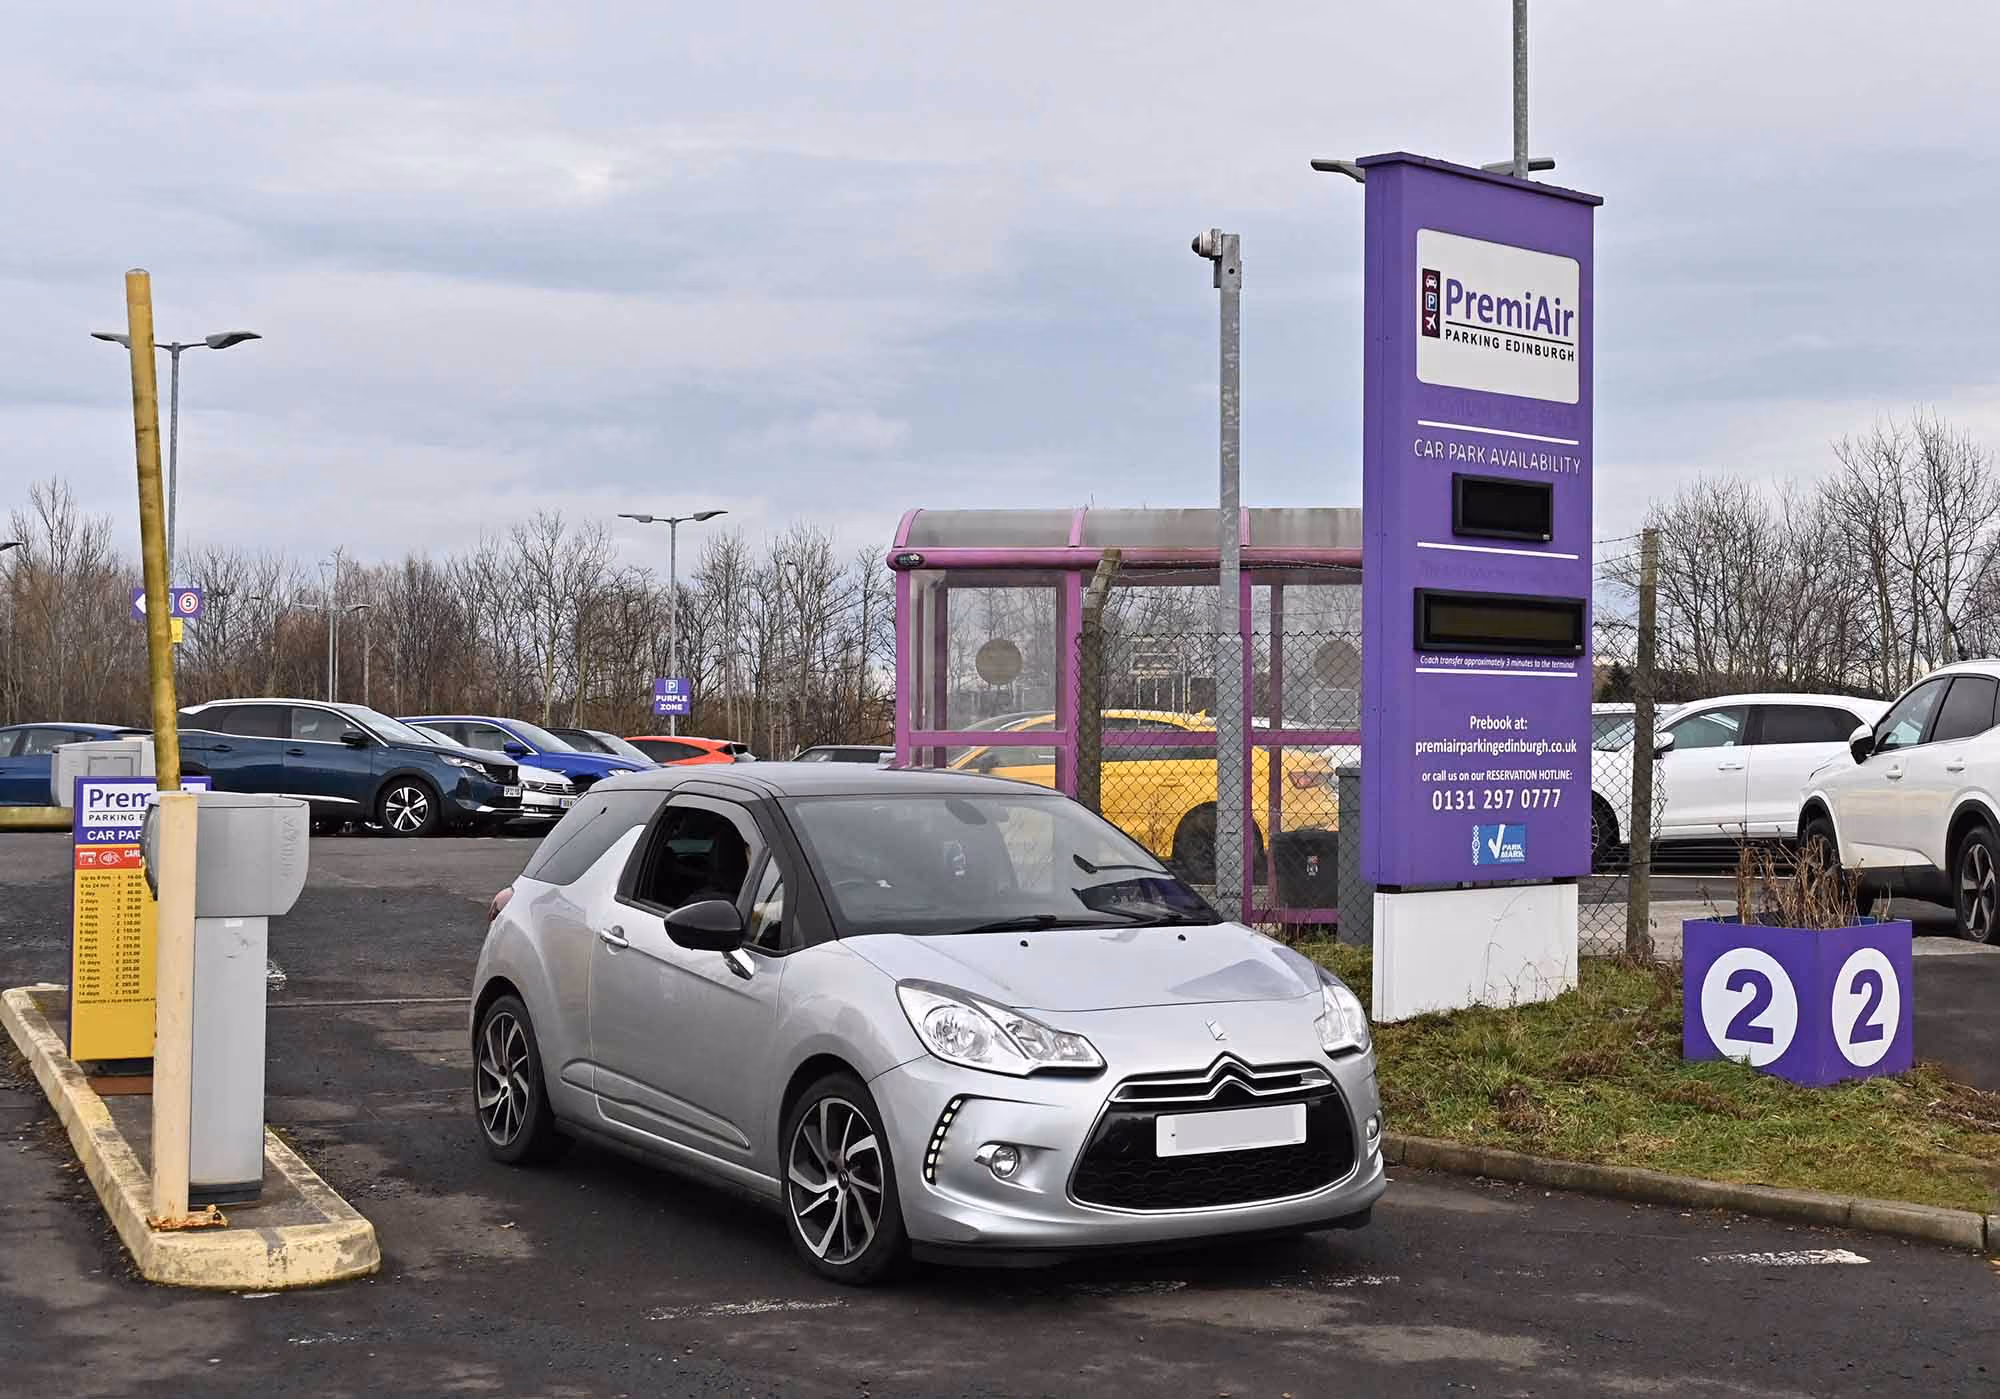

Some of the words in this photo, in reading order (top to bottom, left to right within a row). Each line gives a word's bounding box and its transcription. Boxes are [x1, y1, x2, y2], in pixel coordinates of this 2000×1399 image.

[1445, 278, 1574, 337] PremiAir
[1445, 328, 1500, 349] PARKING
[1505, 338, 1575, 362] EDINBURGH
[1414, 439, 1444, 459] CAR
[1449, 442, 1486, 465] PARK
[1490, 448, 1581, 475] AVAILABILITY
[185, 598, 192, 608] 5
[1420, 655, 1439, 665] Coach
[1440, 655, 1463, 667] transfer
[1463, 656, 1505, 669] approximately
[1506, 658, 1511, 667] 3
[1511, 658, 1533, 668] minutes
[1534, 660, 1541, 668] to
[1541, 659, 1551, 669] the
[1551, 659, 1575, 669] terminal
[668, 681, 675, 691] P
[1470, 715, 1512, 730] Prebook
[1514, 717, 1528, 730] at:
[1415, 738, 1577, 756] premiairparkingedinburgh.co.uk
[1422, 772, 1431, 782] or
[1432, 769, 1447, 782] call
[1448, 772, 1457, 782] us
[1459, 772, 1470, 781] on
[1471, 772, 1485, 781] our
[1486, 769, 1538, 781] RESERVATION
[1539, 768, 1573, 780] HOTLINE:
[1432, 789, 1476, 811] 0131
[1483, 788, 1514, 809] 297
[1521, 788, 1561, 809] 0777
[87, 830, 115, 841] CAR
[1725, 969, 1774, 1045] 2
[1849, 969, 1884, 1045] 2
